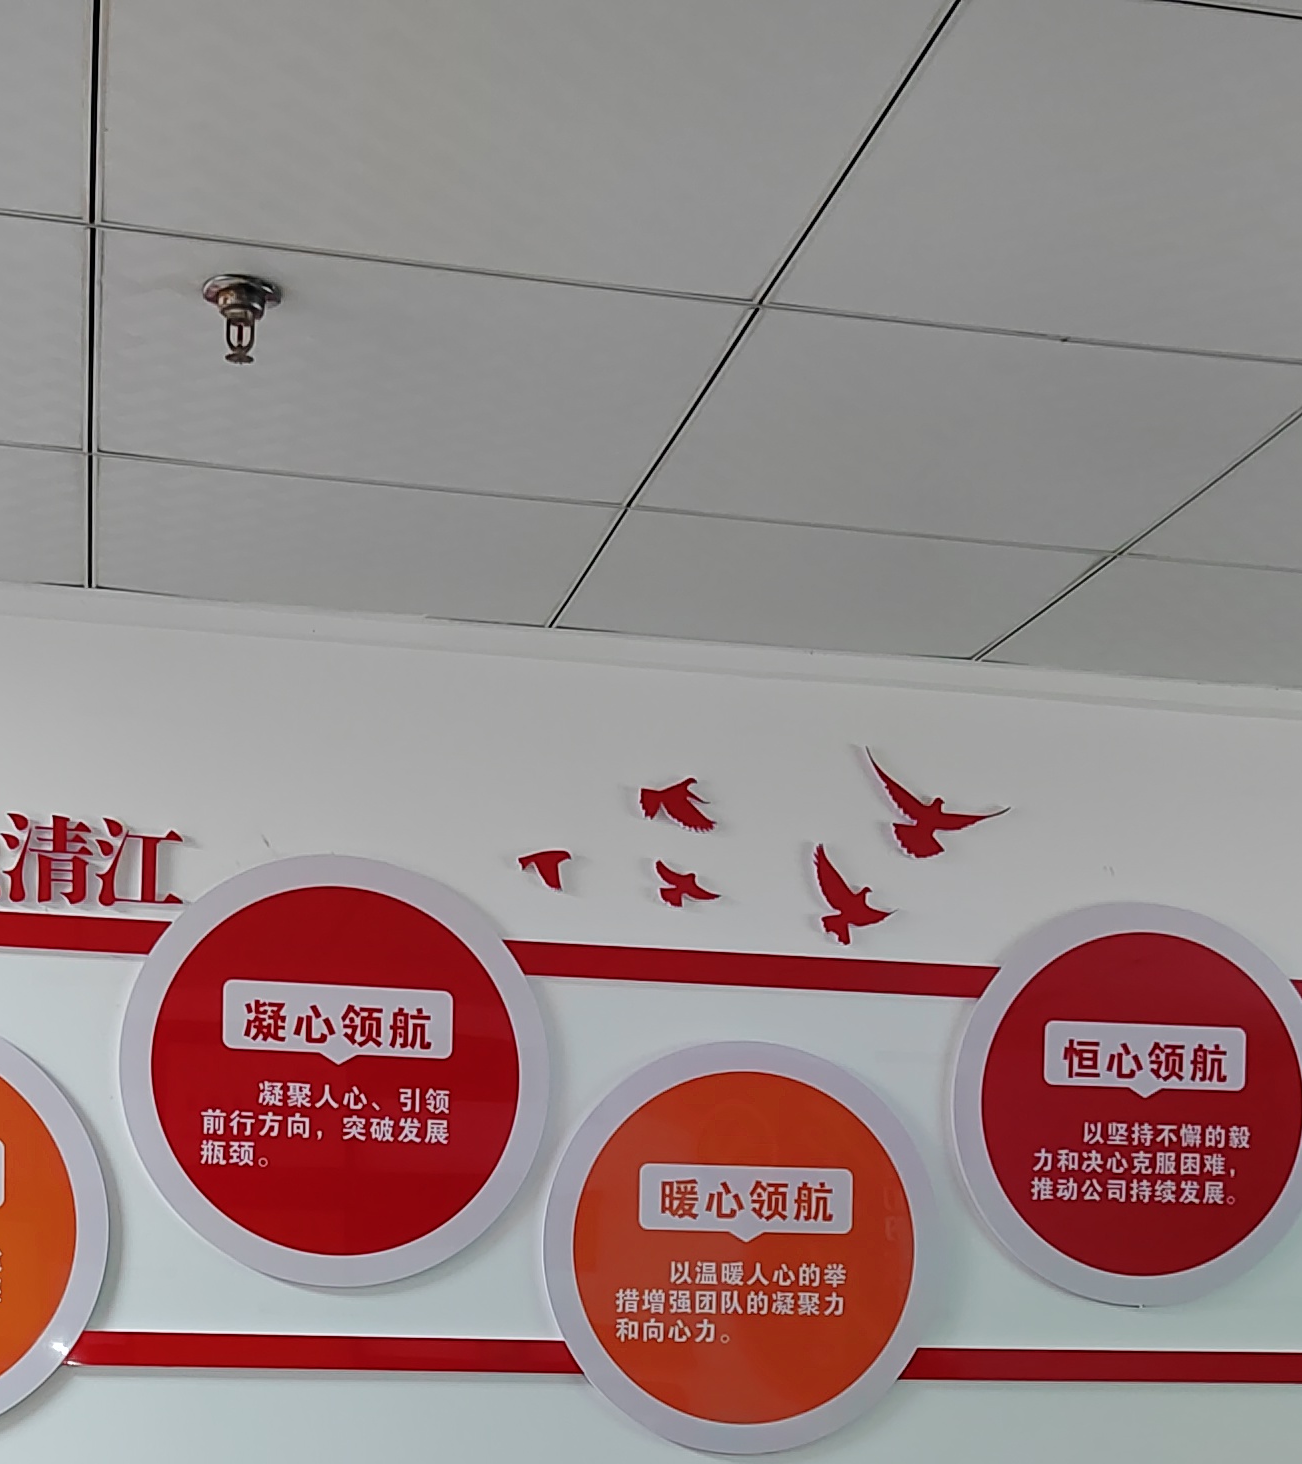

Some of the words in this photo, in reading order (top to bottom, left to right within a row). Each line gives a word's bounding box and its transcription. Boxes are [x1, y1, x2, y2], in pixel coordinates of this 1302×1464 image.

[243, 999, 432, 1050] 凝心领航
[1063, 1039, 1227, 1083] 恒心领航
[258, 1081, 450, 1114] 凝聚人心、引领
[201, 1109, 450, 1144] 前行方向，突破发展
[1083, 1122, 1251, 1149] 以坚持不懈的毅
[200, 1140, 268, 1168] 瓶颈。
[1033, 1148, 1236, 1178] 力和决心克服困难，
[661, 1179, 833, 1222] 暖心领航
[1031, 1177, 1235, 1205] 推动公司持续发展。
[670, 1261, 847, 1287] 以温暖人心的举
[616, 1289, 844, 1316] 措增强团队的凝聚力
[616, 1318, 730, 1344] 和向心力。
